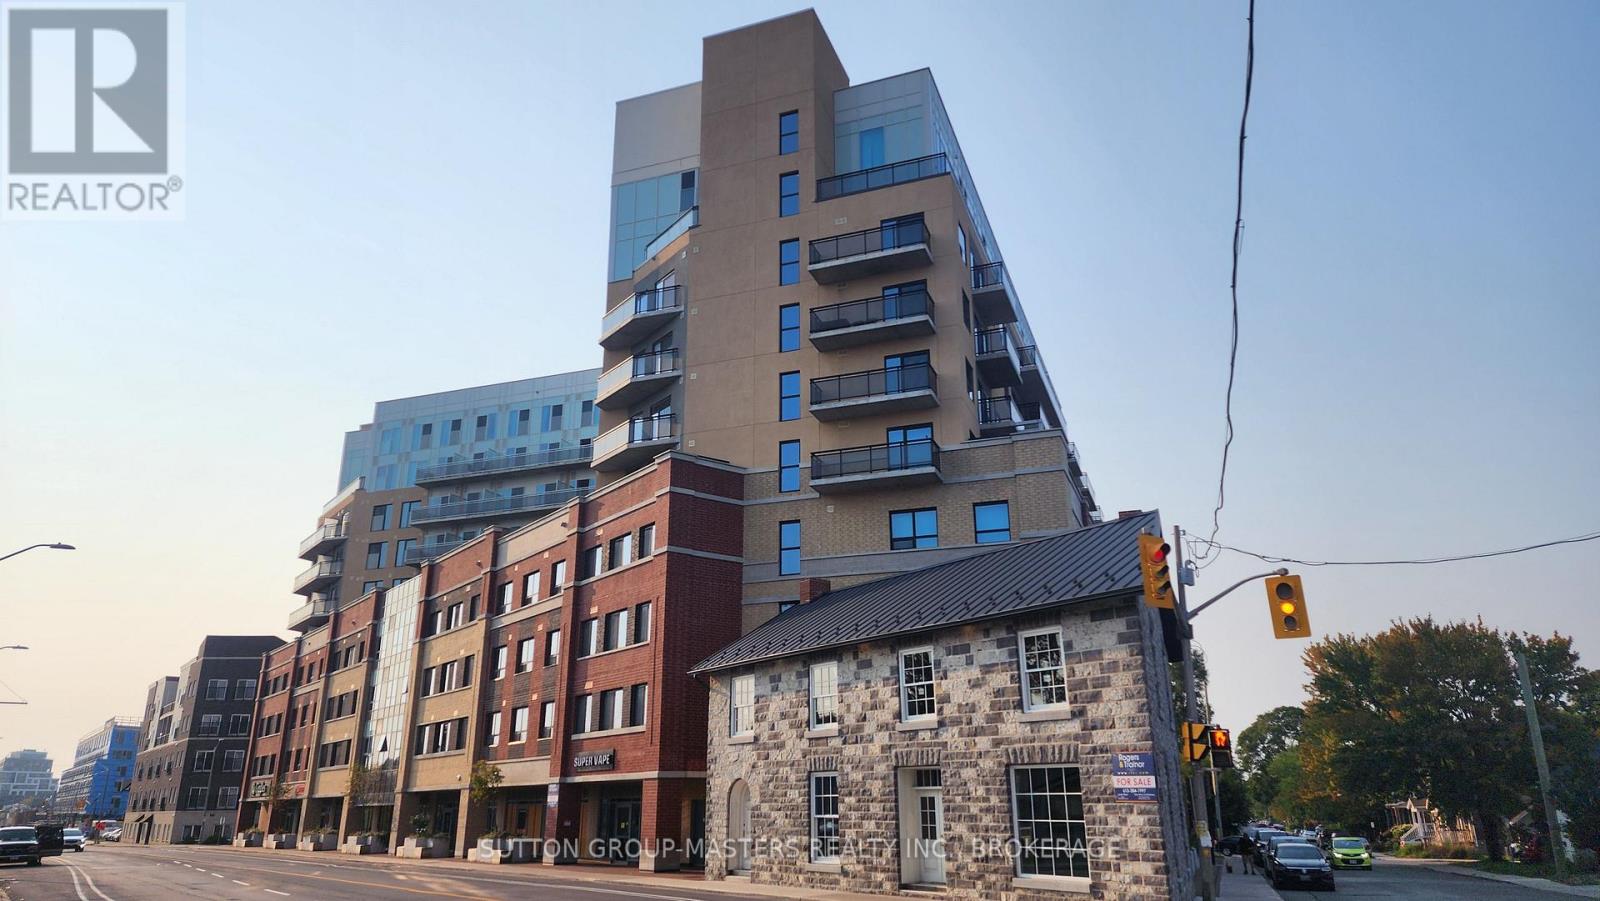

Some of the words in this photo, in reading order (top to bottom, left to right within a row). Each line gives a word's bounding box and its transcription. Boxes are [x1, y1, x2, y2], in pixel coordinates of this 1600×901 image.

[574, 756, 593, 767] SUPER
[594, 754, 610, 765] VAPE
[1117, 778, 1131, 786] FOR
[1133, 778, 1152, 786] SALE
